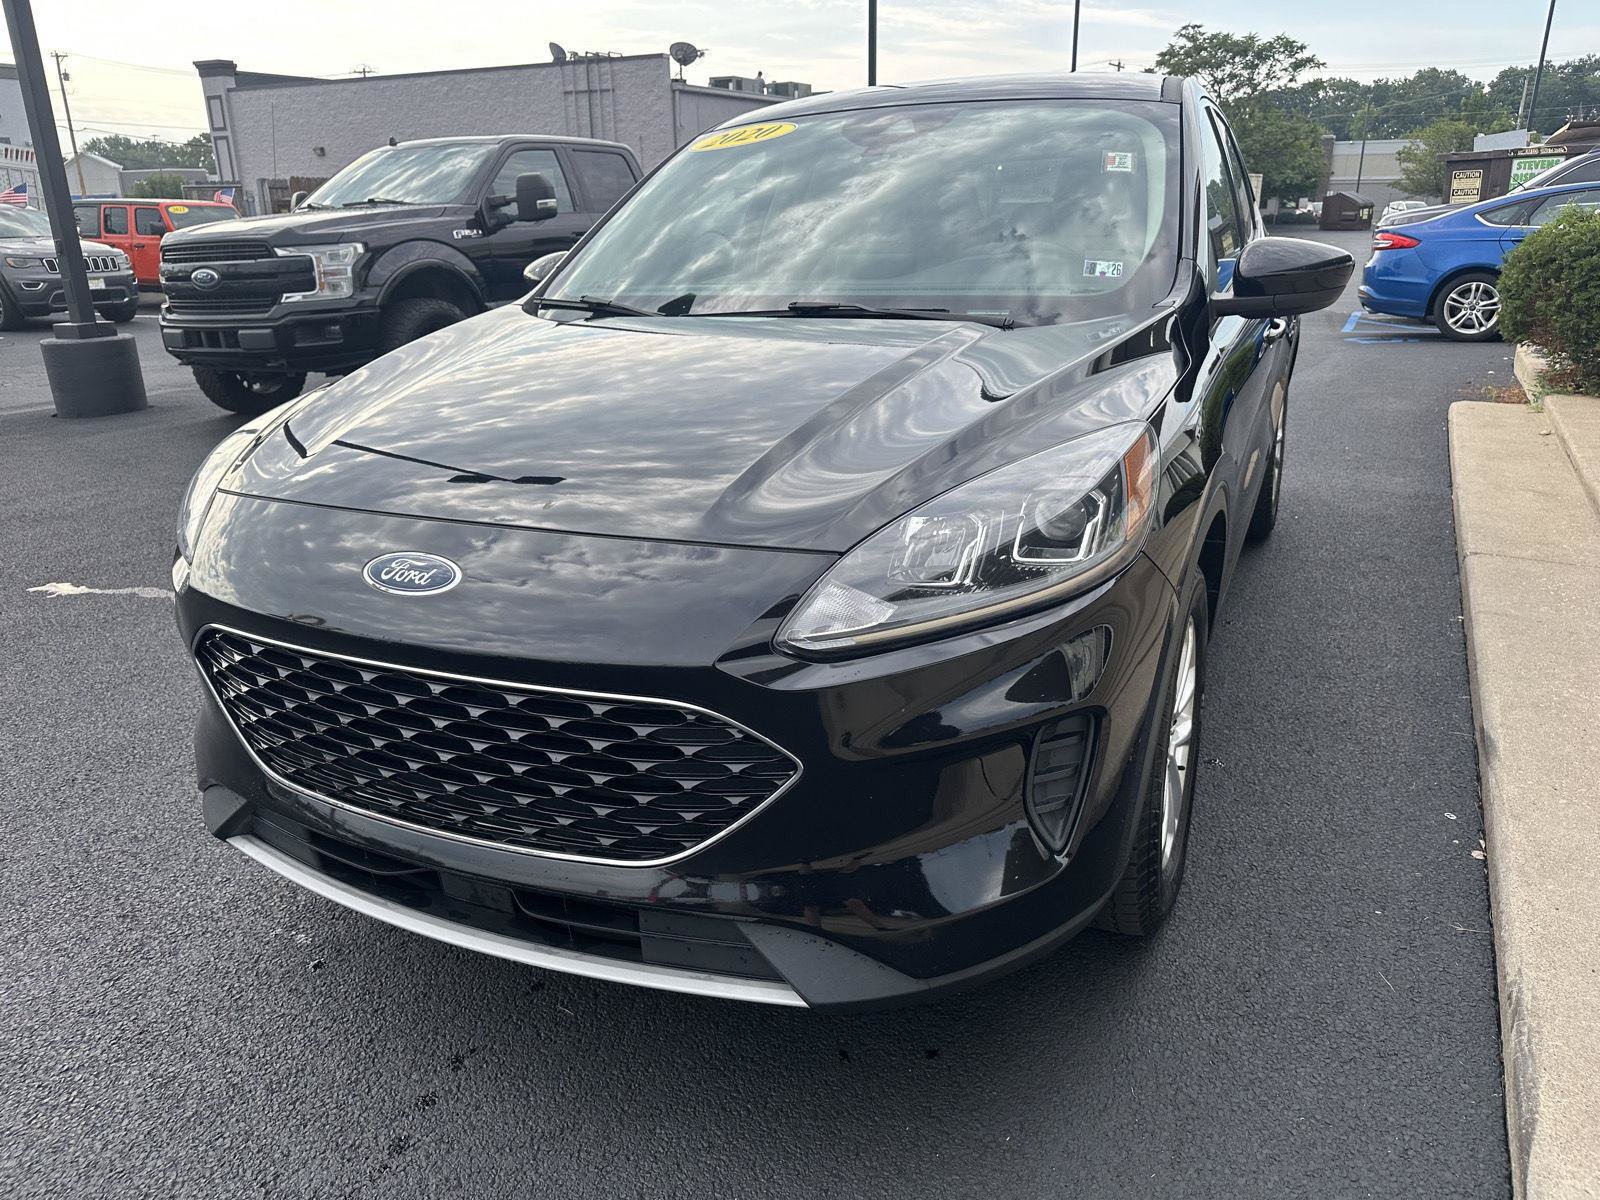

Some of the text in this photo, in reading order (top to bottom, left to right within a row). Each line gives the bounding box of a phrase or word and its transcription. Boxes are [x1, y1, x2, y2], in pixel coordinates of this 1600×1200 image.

[700, 125, 783, 149] 2020
[1455, 171, 1480, 179] CAUTION
[1453, 188, 1478, 196] CAUTION
[1111, 263, 1122, 276] 26
[381, 558, 438, 585] Ford
